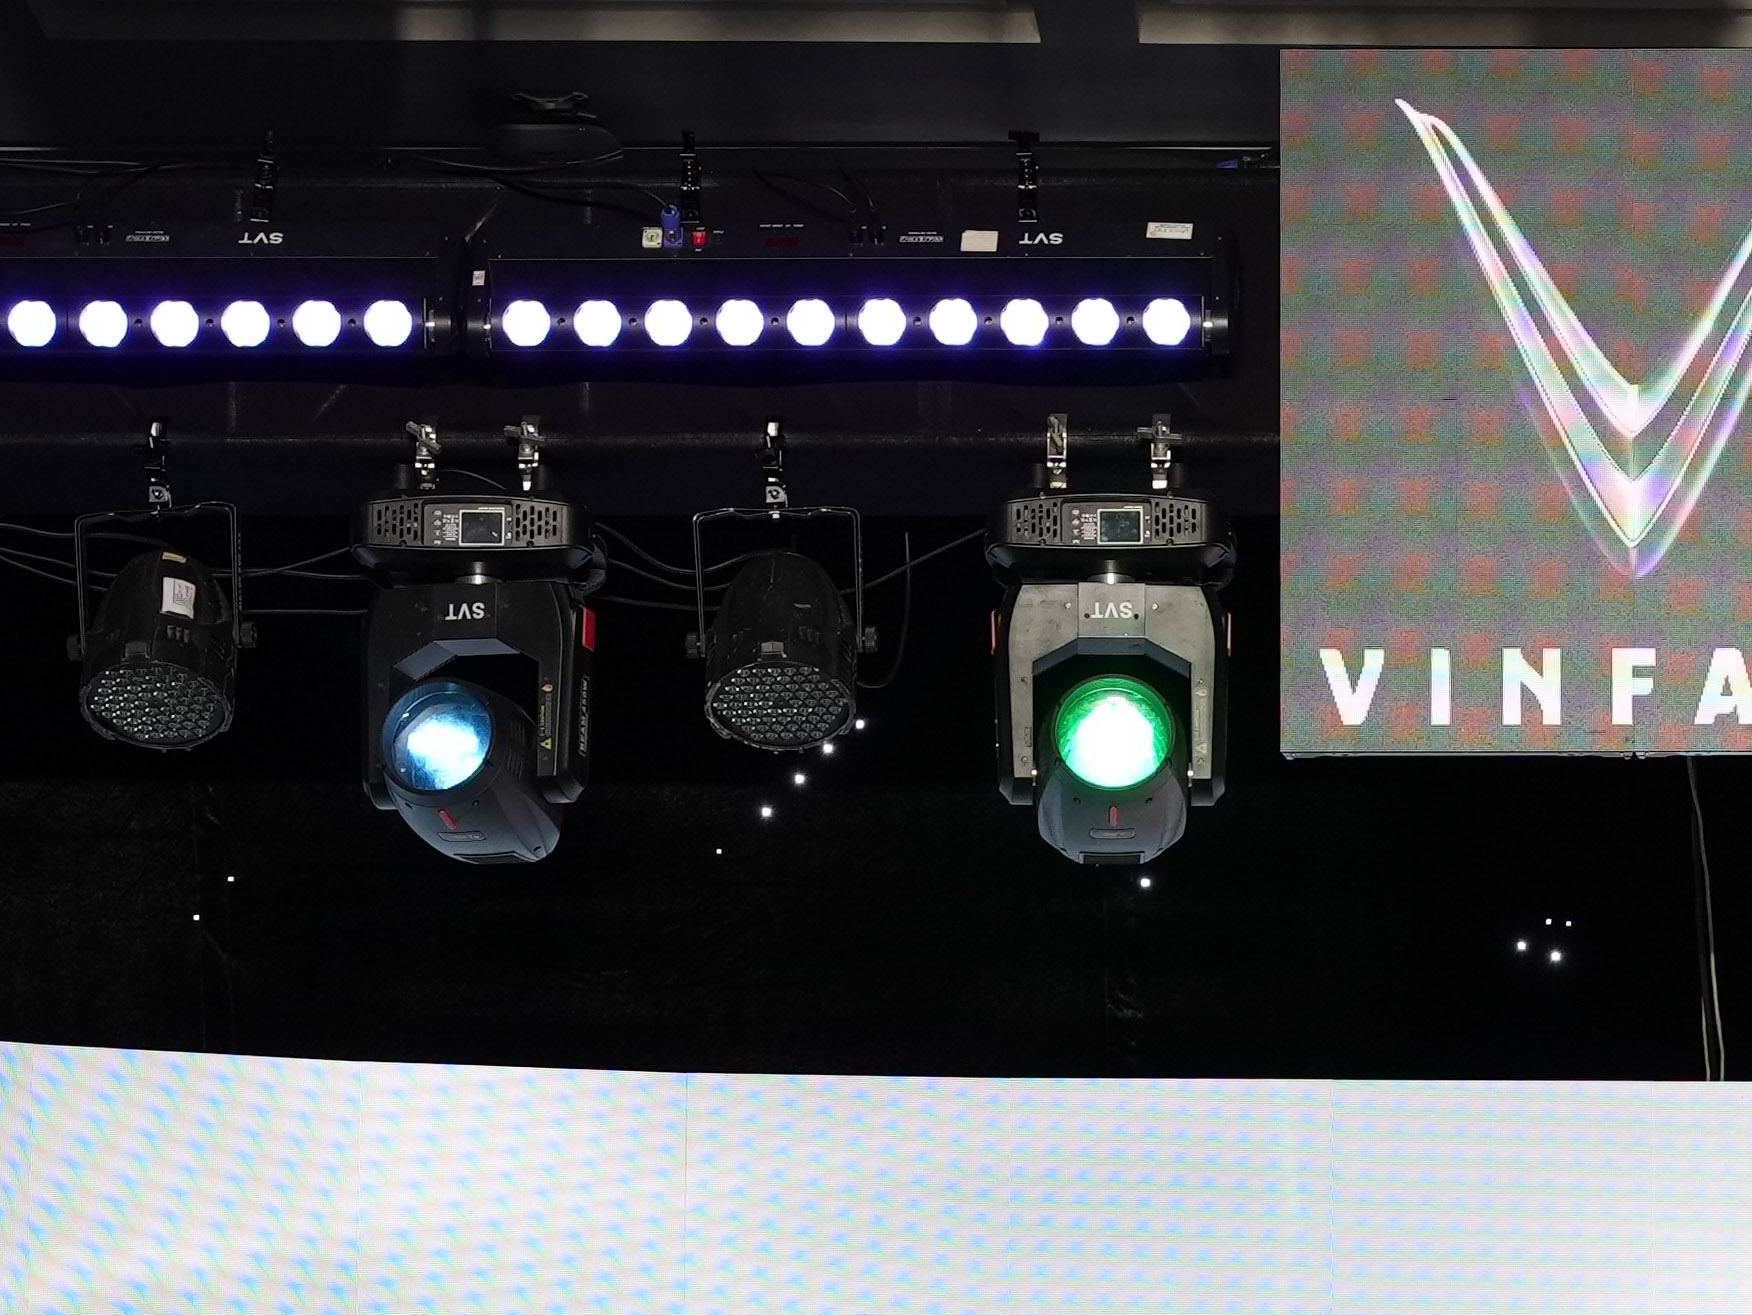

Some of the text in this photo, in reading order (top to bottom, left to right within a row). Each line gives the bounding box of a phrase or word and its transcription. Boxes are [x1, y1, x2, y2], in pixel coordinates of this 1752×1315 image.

[239, 232, 283, 244] SVT
[1019, 233, 1063, 244] SVT
[445, 603, 485, 620] SVT
[1091, 602, 1132, 618] SVT
[579, 714, 587, 752] BEAM
